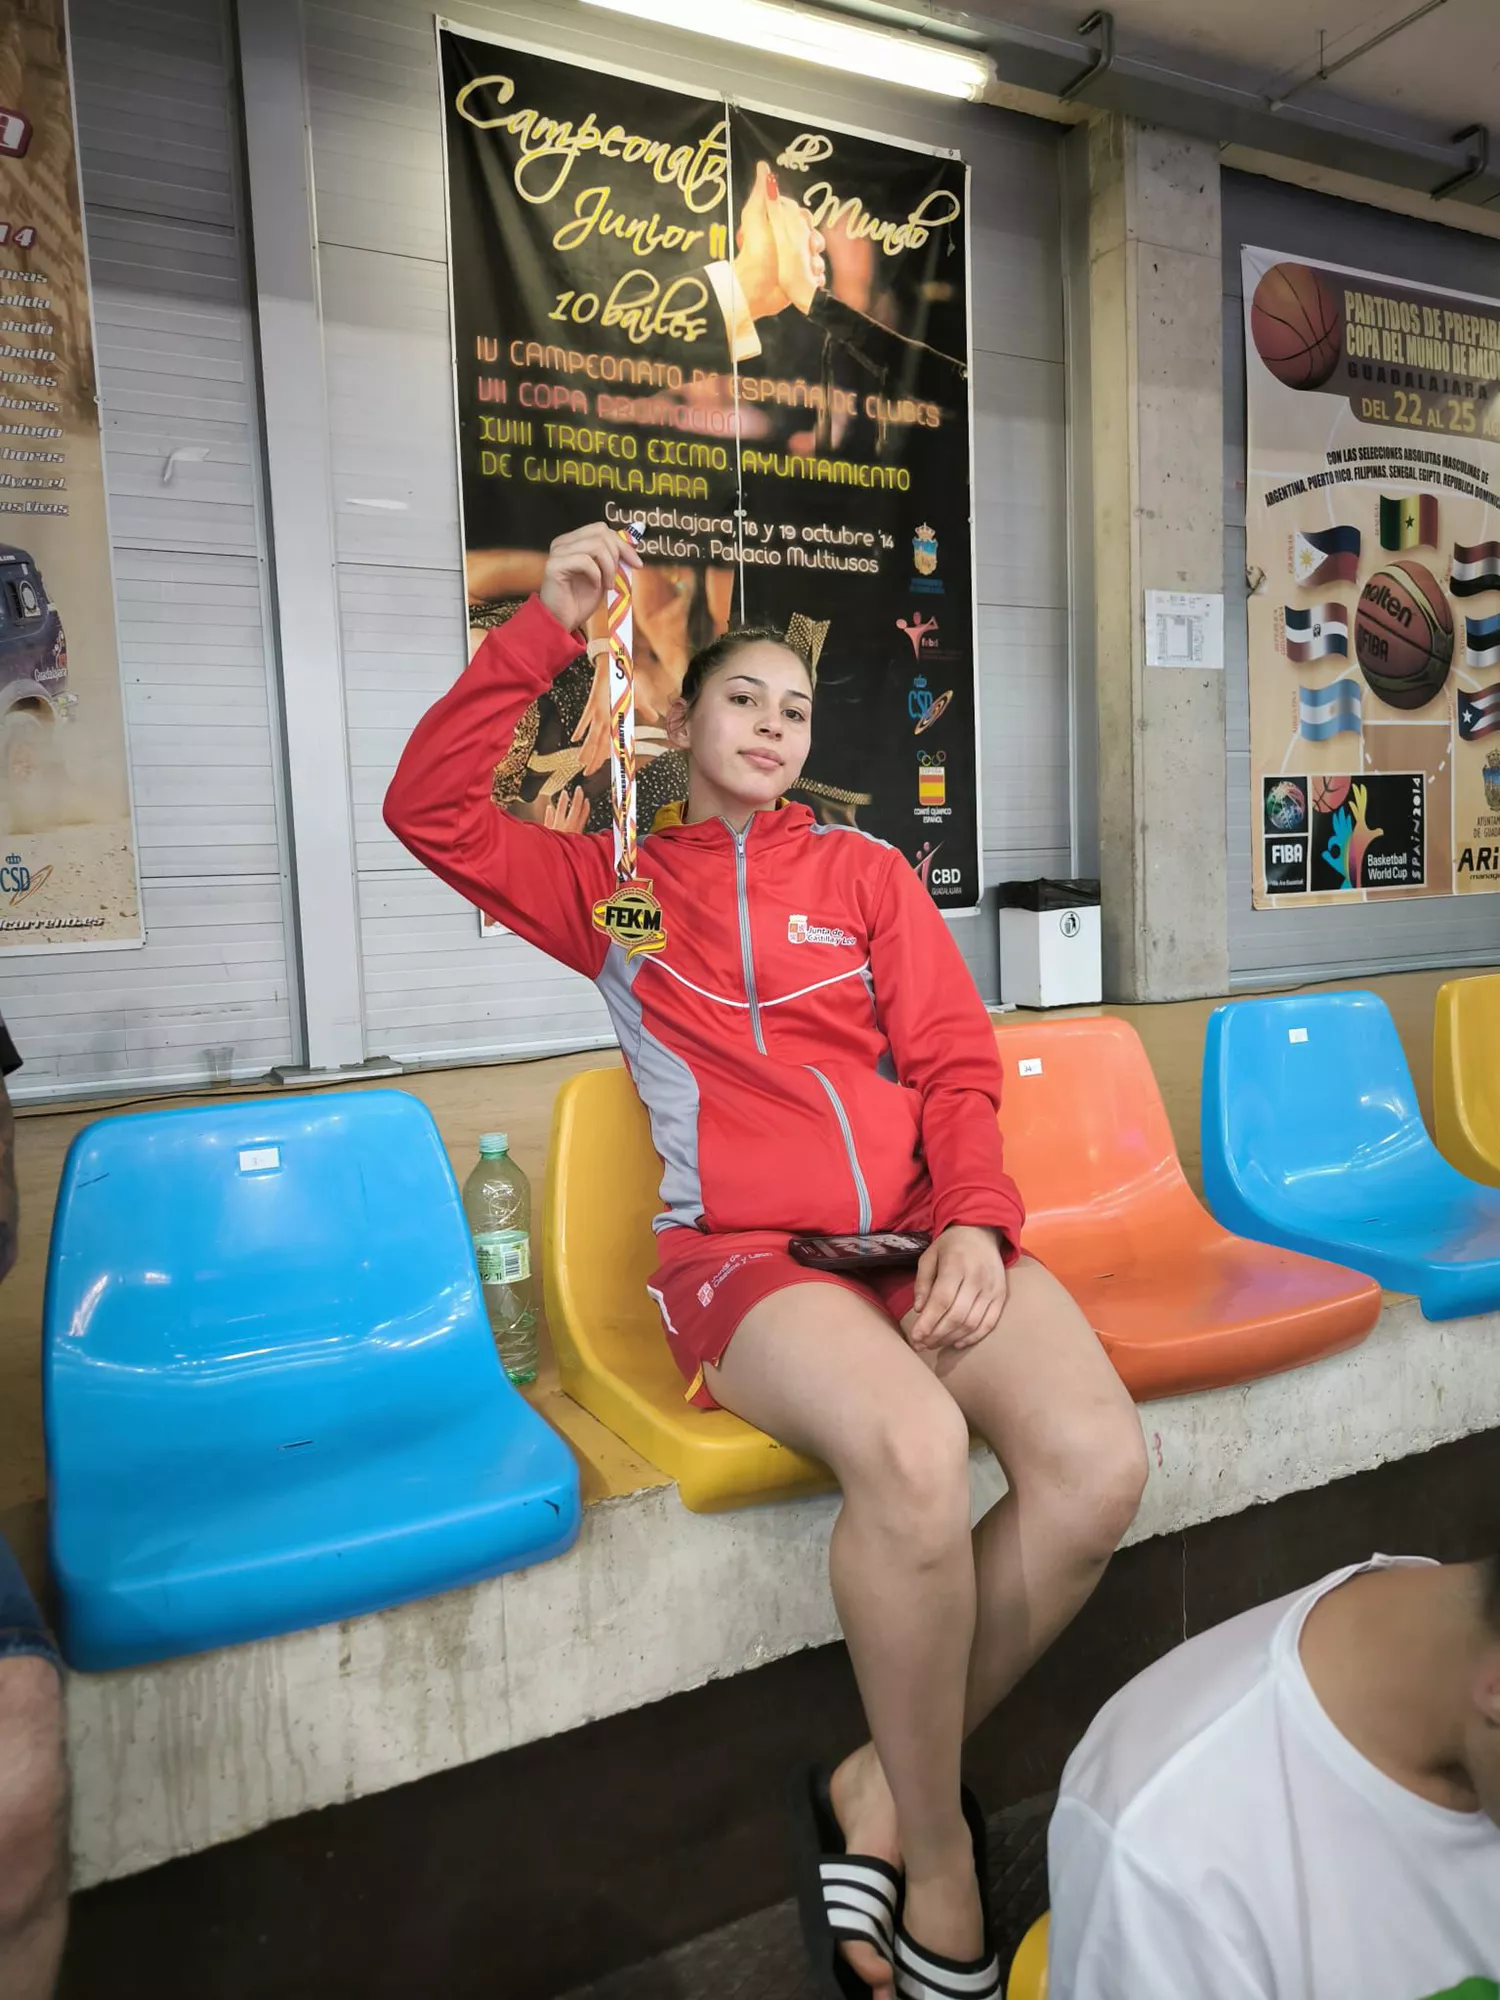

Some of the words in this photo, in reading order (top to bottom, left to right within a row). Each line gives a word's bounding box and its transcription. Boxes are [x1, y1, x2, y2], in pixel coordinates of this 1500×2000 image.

[456, 75, 728, 213] Campeonato
[776, 133, 834, 172] del
[553, 186, 704, 257] Junior
[803, 181, 960, 257] Mundo
[548, 291, 597, 323] 10
[601, 269, 708, 344] bailes
[1344, 290, 1421, 335] PARTIDOS
[1423, 306, 1442, 339] DE
[1444, 310, 1500, 350] PREPAR
[1346, 323, 1381, 360] COPA
[1382, 330, 1405, 364] DEL
[1406, 334, 1450, 373] MUNDO
[1452, 343, 1468, 376] DE
[510, 341, 683, 390] CAMPEONATO
[832, 389, 858, 416] DE
[865, 396, 941, 428] CLUBES
[519, 382, 588, 415] COPA
[1347, 360, 1488, 400] GUADALAJARA
[1362, 397, 1390, 421] DEL
[1393, 390, 1423, 426] 22
[1426, 408, 1444, 429] AL
[1448, 399, 1476, 433] 25
[478, 415, 533, 446] XVIII
[544, 423, 638, 460] TROFEO
[741, 450, 911, 492] AYUNTAMIENTO
[1326, 448, 1342, 465] CON
[1343, 447, 1358, 463] LAS
[1358, 446, 1403, 461] SELECCIONES
[1403, 447, 1442, 467] ABSOLUTAS
[1442, 455, 1481, 481] MASCULINAS
[1481, 470, 1489, 485] DE
[481, 451, 513, 478] DE
[524, 456, 709, 501] GUADALAJARA
[1307, 471, 1335, 491] PUERTO
[604, 501, 737, 539] Guadalajara,
[742, 521, 759, 537] 18
[764, 523, 775, 542] y
[779, 525, 796, 541] 19
[802, 524, 876, 547] octubre
[711, 540, 782, 566] Palacio
[786, 546, 880, 574] Multiusos
[1362, 632, 1389, 662] FIBA
[1271, 844, 1303, 864] FIBA
[1367, 853, 1407, 867] Basketball
[1368, 867, 1392, 881] World
[1392, 866, 1408, 881] Cup
[0, 867, 31, 892] CSD
[931, 868, 961, 885] CBD
[605, 905, 661, 931] FEKM
